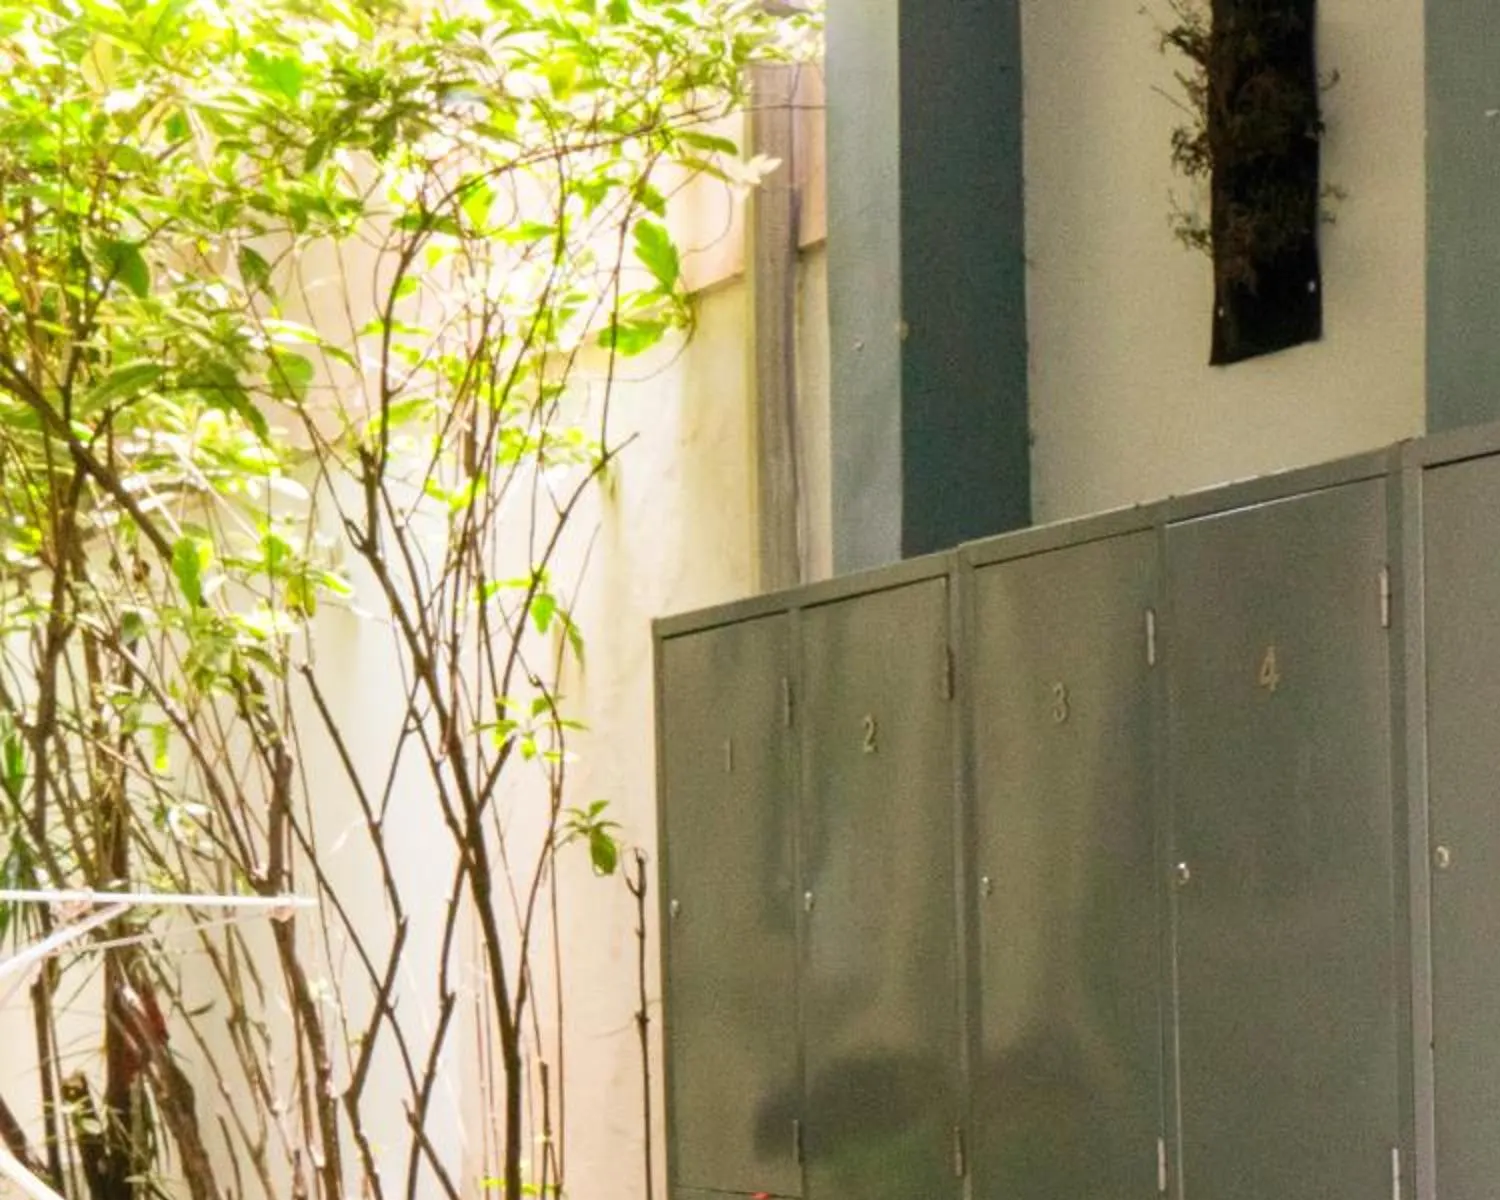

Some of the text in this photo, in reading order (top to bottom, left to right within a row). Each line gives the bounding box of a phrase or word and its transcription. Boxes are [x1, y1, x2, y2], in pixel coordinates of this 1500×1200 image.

[1259, 645, 1280, 691] 4
[1053, 681, 1070, 723] 3
[862, 712, 879, 753] 2
